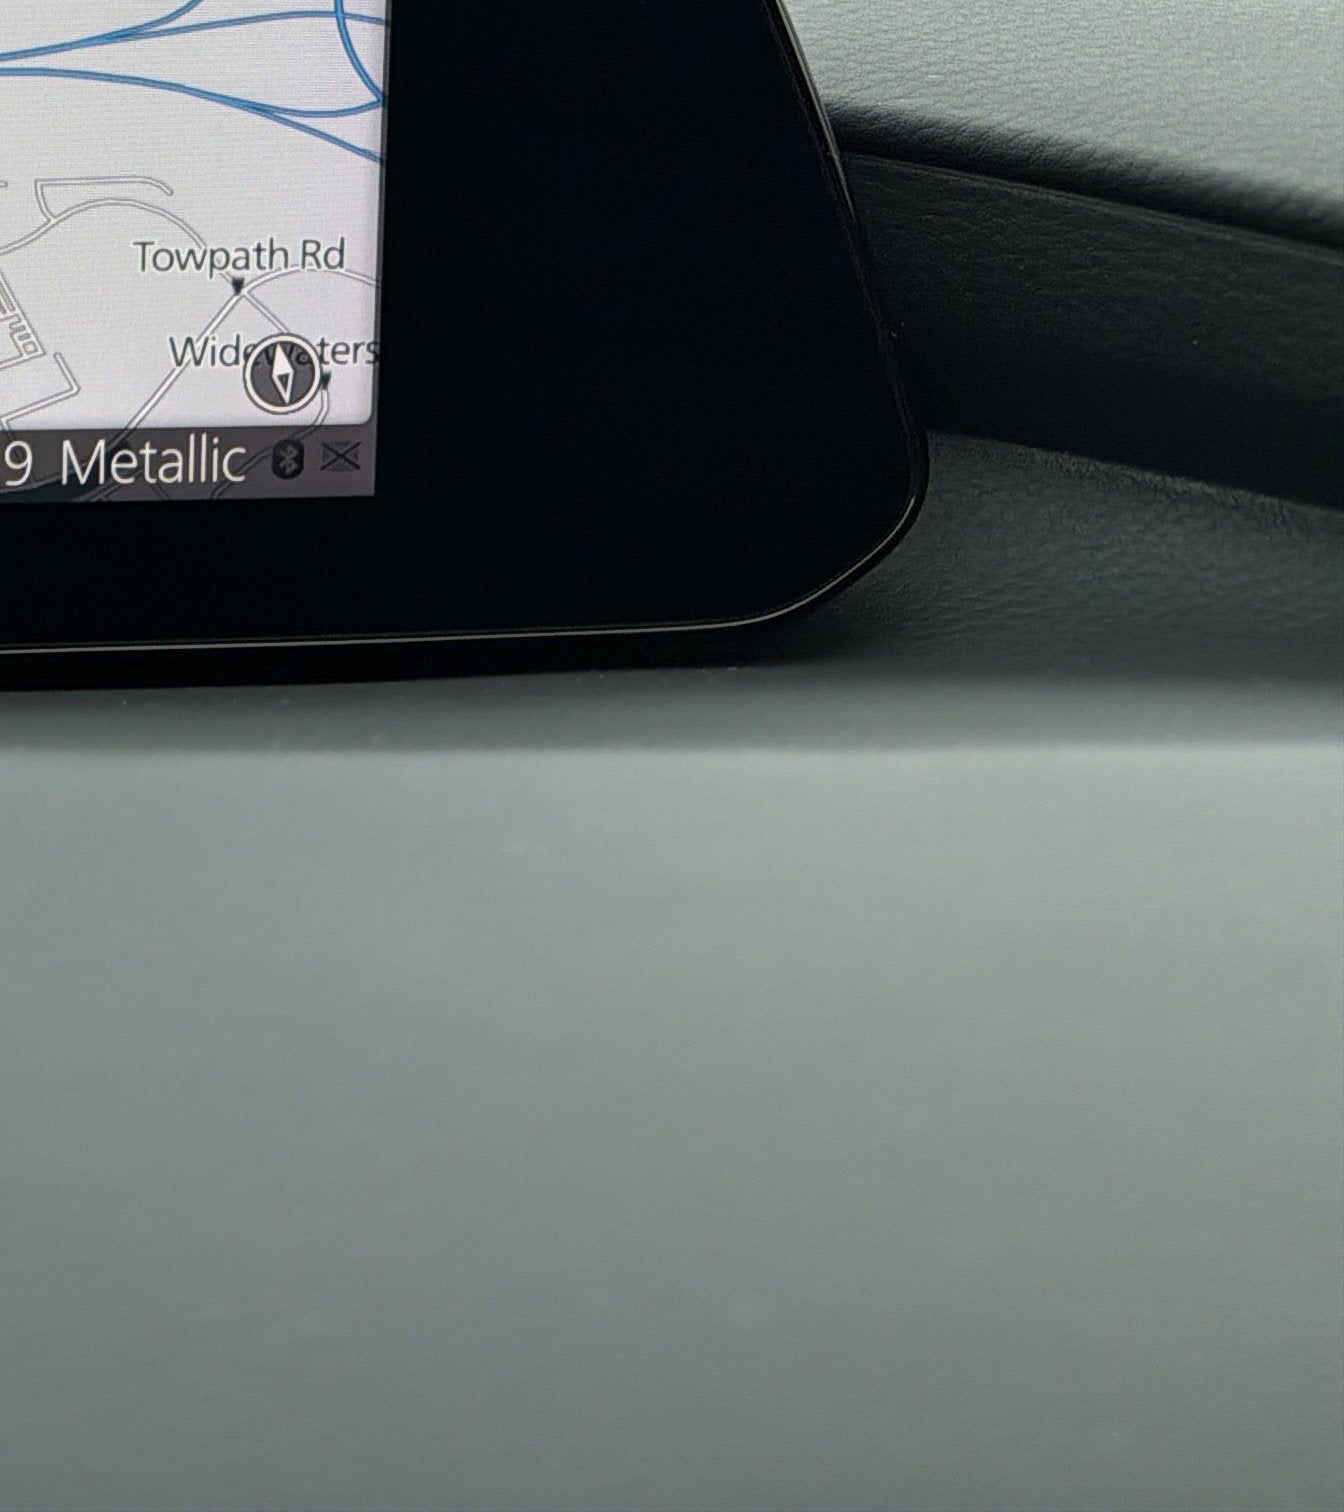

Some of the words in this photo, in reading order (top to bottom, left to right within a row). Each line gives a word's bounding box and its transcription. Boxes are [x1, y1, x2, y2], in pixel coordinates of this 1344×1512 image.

[134, 239, 290, 281] Towpath
[303, 236, 346, 270] Rd
[59, 433, 247, 488] Metallic
